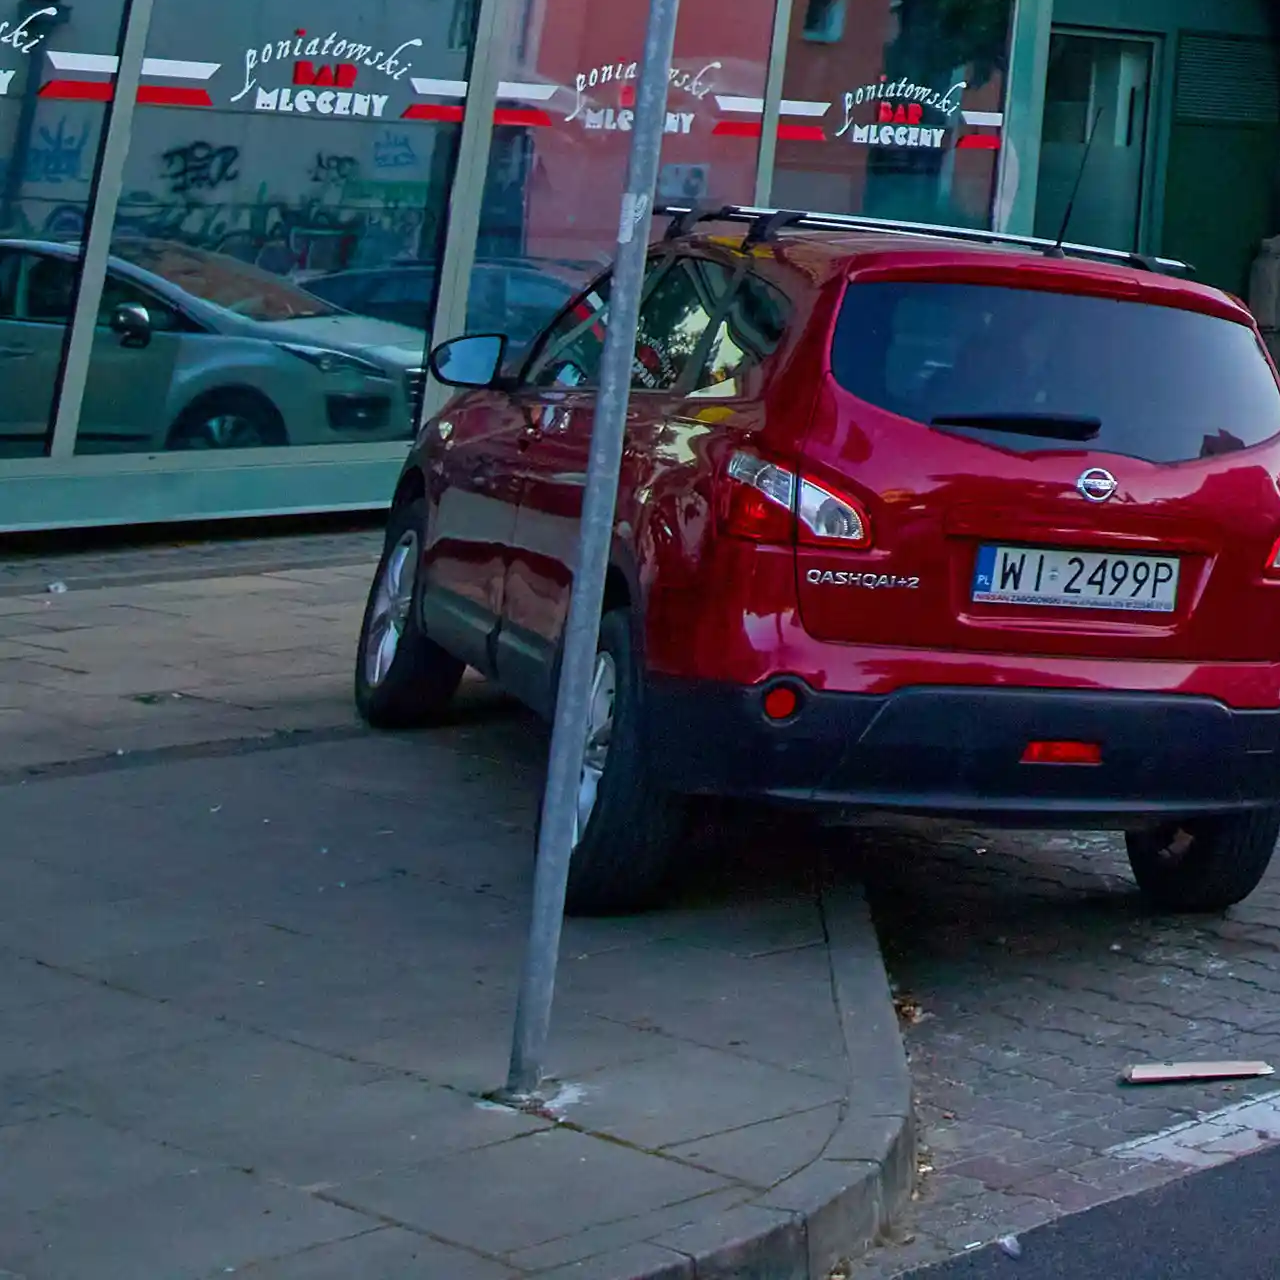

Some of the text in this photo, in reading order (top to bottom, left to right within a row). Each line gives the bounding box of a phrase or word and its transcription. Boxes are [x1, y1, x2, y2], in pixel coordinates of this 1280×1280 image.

[230, 28, 423, 102] poniatowski
[292, 60, 358, 88] BAR
[564, 56, 722, 122] poniaski
[835, 74, 967, 137] poniatowski
[877, 101, 923, 125] BAR
[584, 108, 695, 134] MLENY
[806, 569, 920, 589] QASHQAI+2
[976, 574, 990, 586] PL
[1000, 552, 1173, 599] WI 2499P
